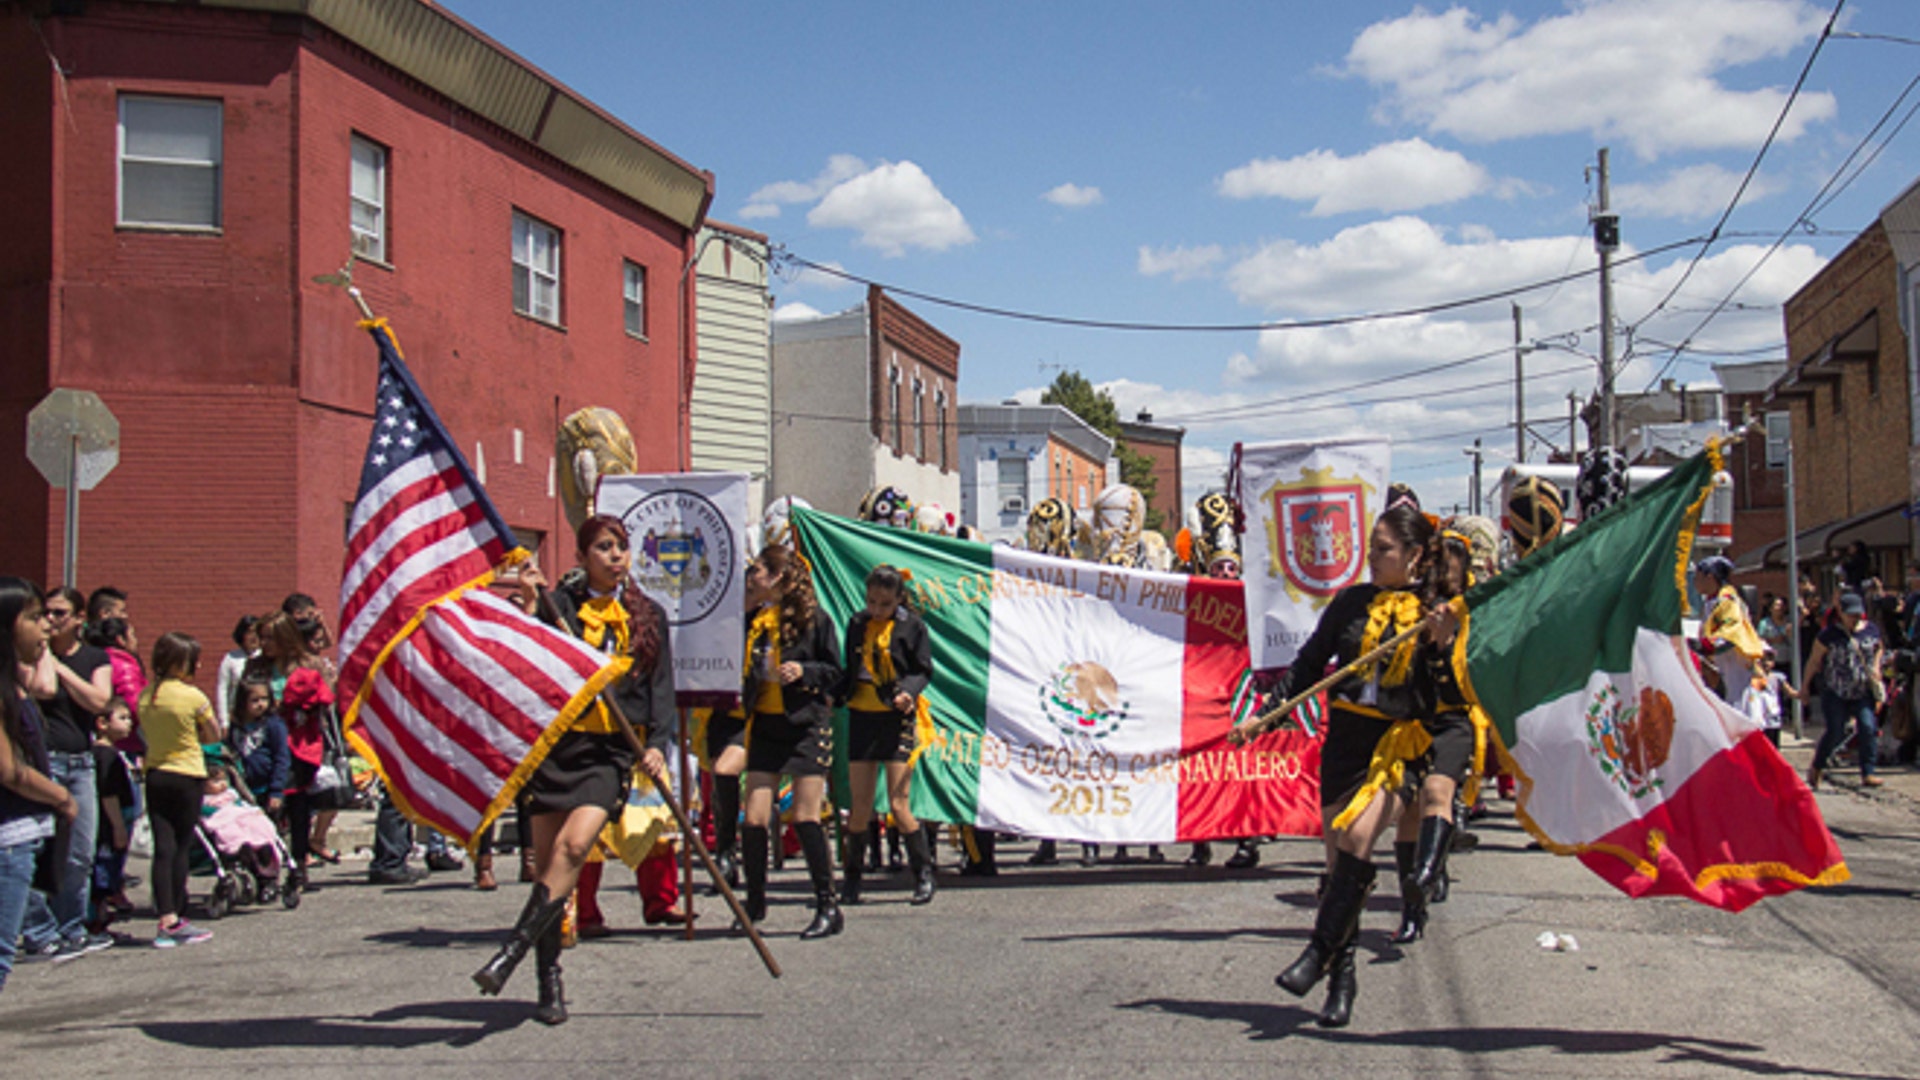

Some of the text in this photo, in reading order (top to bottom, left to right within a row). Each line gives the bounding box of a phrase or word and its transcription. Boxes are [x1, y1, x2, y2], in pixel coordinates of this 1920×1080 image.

[636, 499, 670, 522] CITY
[675, 498, 695, 511] OF
[956, 567, 1085, 604] CARNAVAL
[1096, 571, 1130, 604] EN
[1021, 741, 1119, 782] OZOLCO
[1129, 750, 1302, 784] CARNAVALERO
[1048, 783, 1132, 817] 2015
